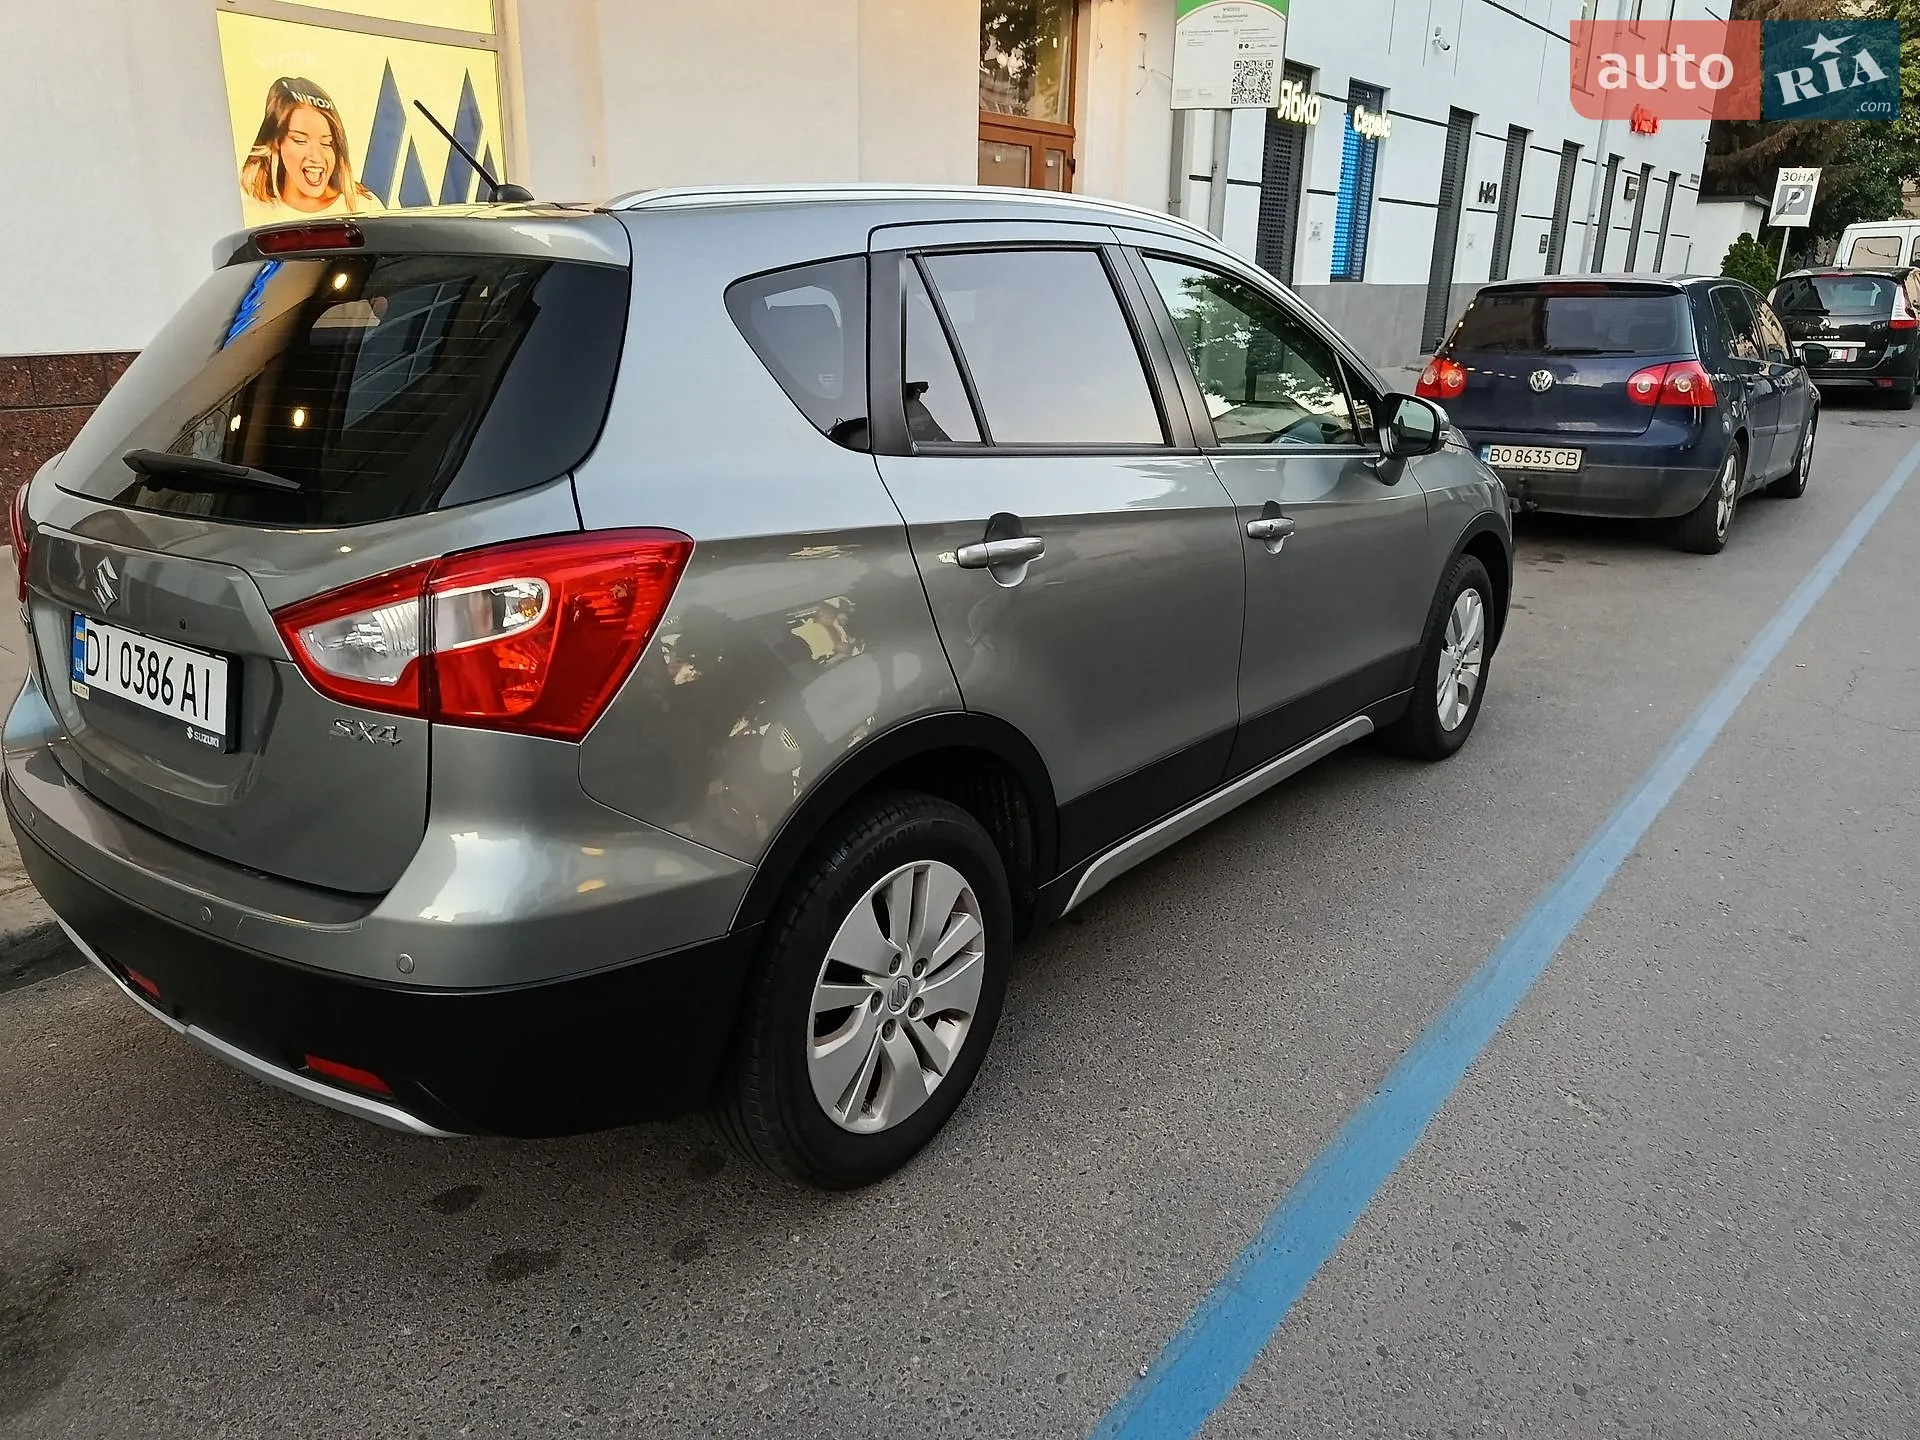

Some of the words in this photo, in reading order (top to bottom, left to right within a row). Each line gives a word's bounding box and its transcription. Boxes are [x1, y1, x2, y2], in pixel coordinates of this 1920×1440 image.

[1277, 79, 1321, 126] Ябко
[1781, 171, 1814, 182] ЗОНА
[1490, 448, 1512, 462] BO
[1514, 449, 1552, 465] 8635
[1554, 451, 1578, 466] CB
[86, 628, 110, 682] DI
[120, 641, 174, 706] 0386
[180, 662, 210, 721] AI
[193, 732, 219, 748] SUZUKI
[332, 718, 402, 747] SX4
